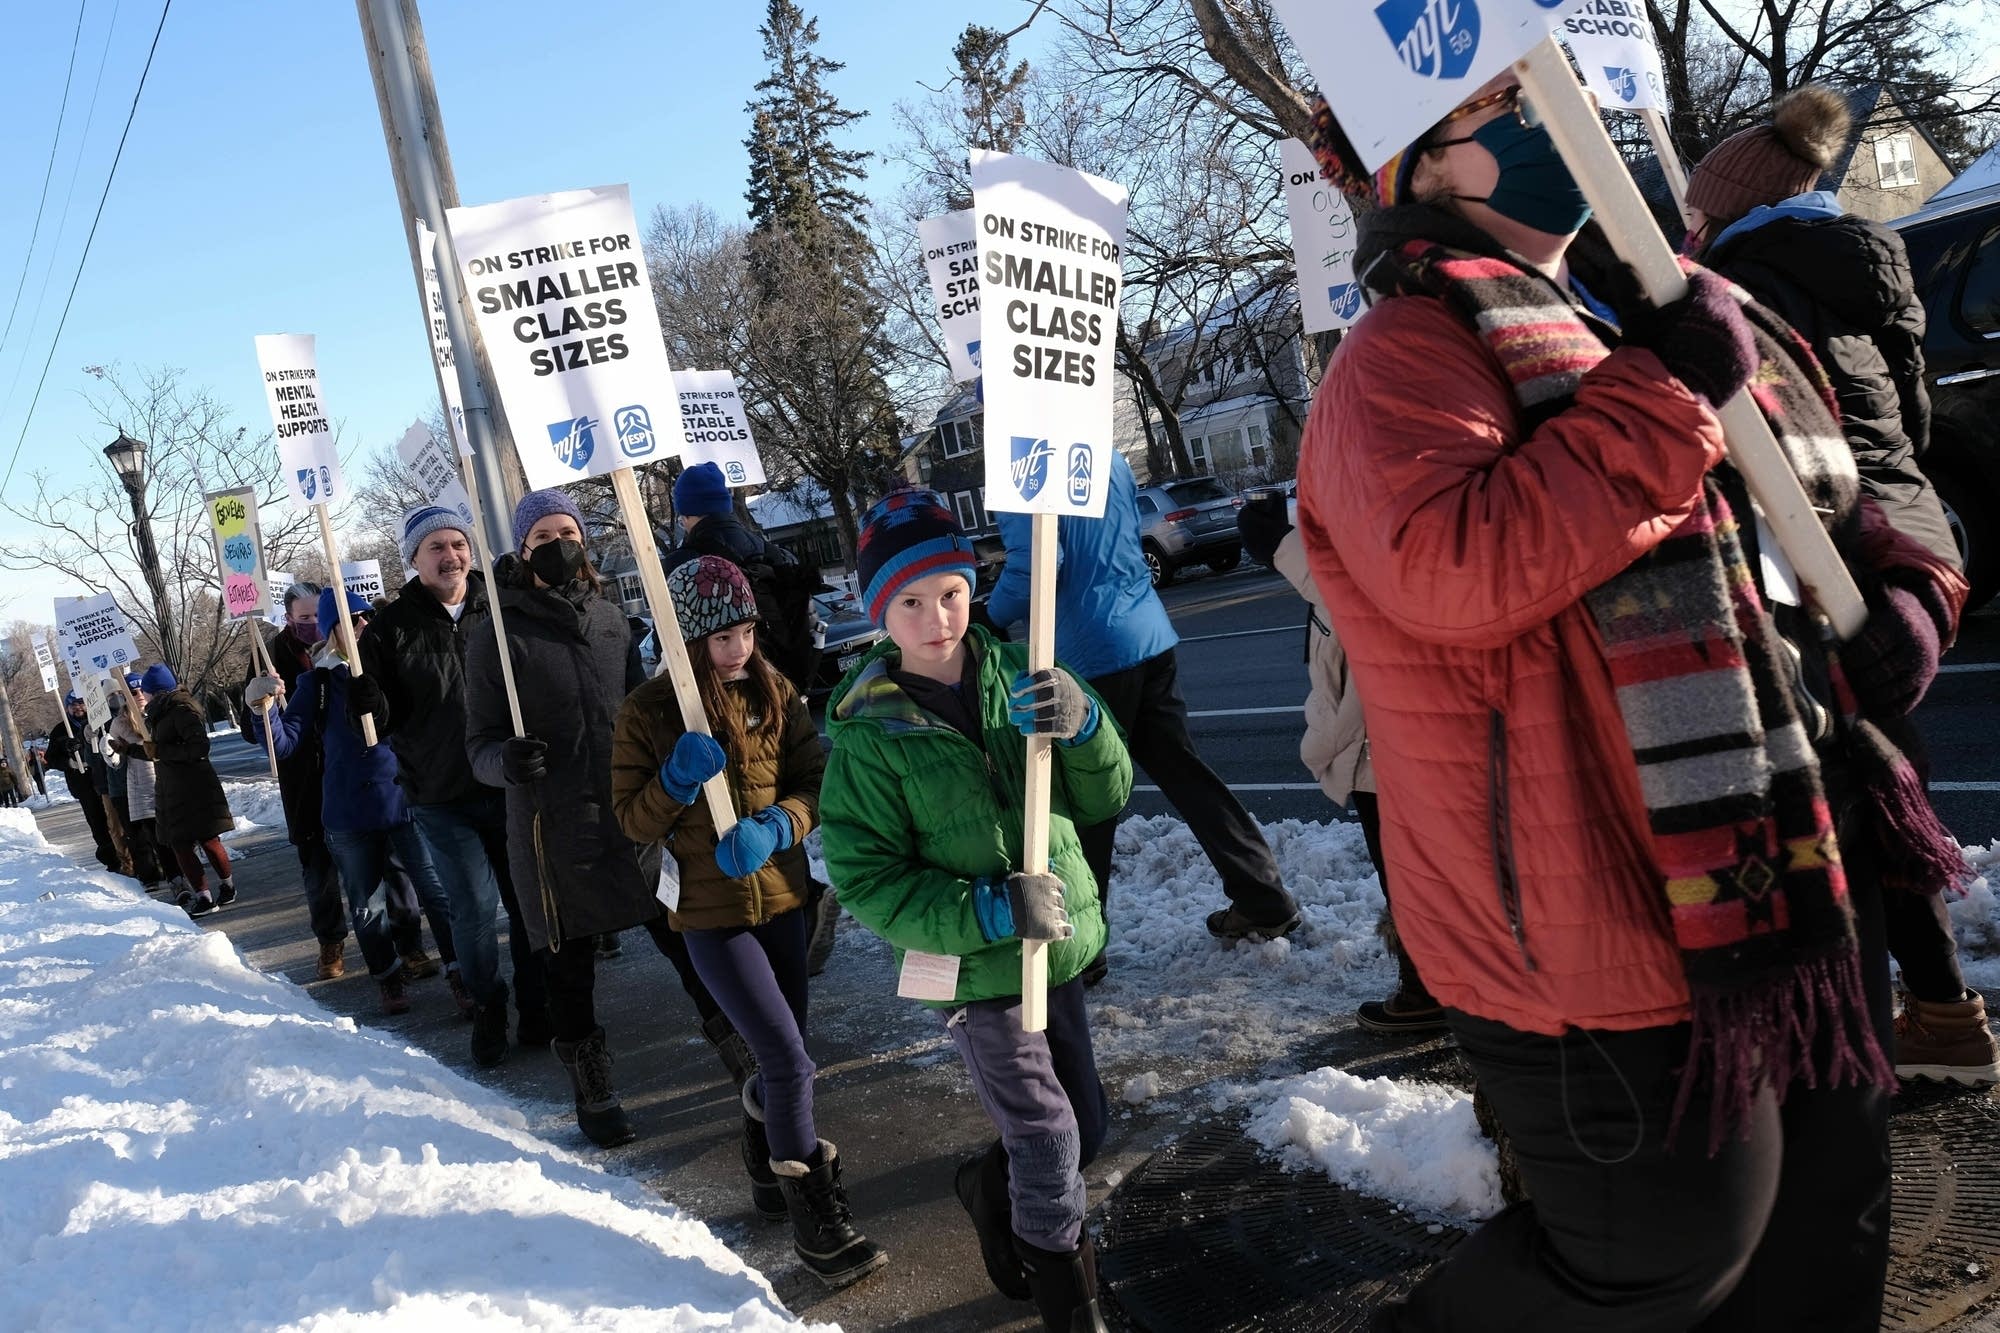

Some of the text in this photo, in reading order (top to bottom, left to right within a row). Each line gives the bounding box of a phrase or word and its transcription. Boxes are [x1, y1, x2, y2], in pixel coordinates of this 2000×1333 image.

[1575, 0, 1645, 21] TABLE
[1449, 29, 1472, 55] 59
[1291, 171, 1315, 186] ON
[984, 213, 1120, 264] ON STRIKE FOR
[468, 233, 631, 276] ON STRIKE FOR
[927, 248, 945, 260] ON
[477, 261, 641, 314] SMALLER
[985, 250, 1117, 310] SMALLER
[941, 296, 981, 320] SCH
[513, 298, 628, 343] CLASS
[1006, 299, 1101, 346] CLASS
[529, 333, 629, 377] SIZES
[1013, 343, 1095, 387] SIZES
[266, 369, 316, 382] ON STRIKE FOR
[275, 385, 315, 402] MENTAL
[680, 391, 735, 400] STRIKE FOR
[280, 402, 319, 419] HEALTH
[277, 418, 328, 438] SUPPORTS
[628, 433, 645, 446] ESP
[577, 450, 587, 460] 59
[1029, 479, 1039, 490] 59
[1074, 477, 1087, 489] ESP
[345, 581, 379, 593] VING
[76, 611, 100, 622] STRIKE
[101, 606, 115, 615] FOR
[74, 615, 113, 632] MENTAL
[78, 622, 116, 639] HEALTH
[75, 627, 125, 648] SUPPORTS
